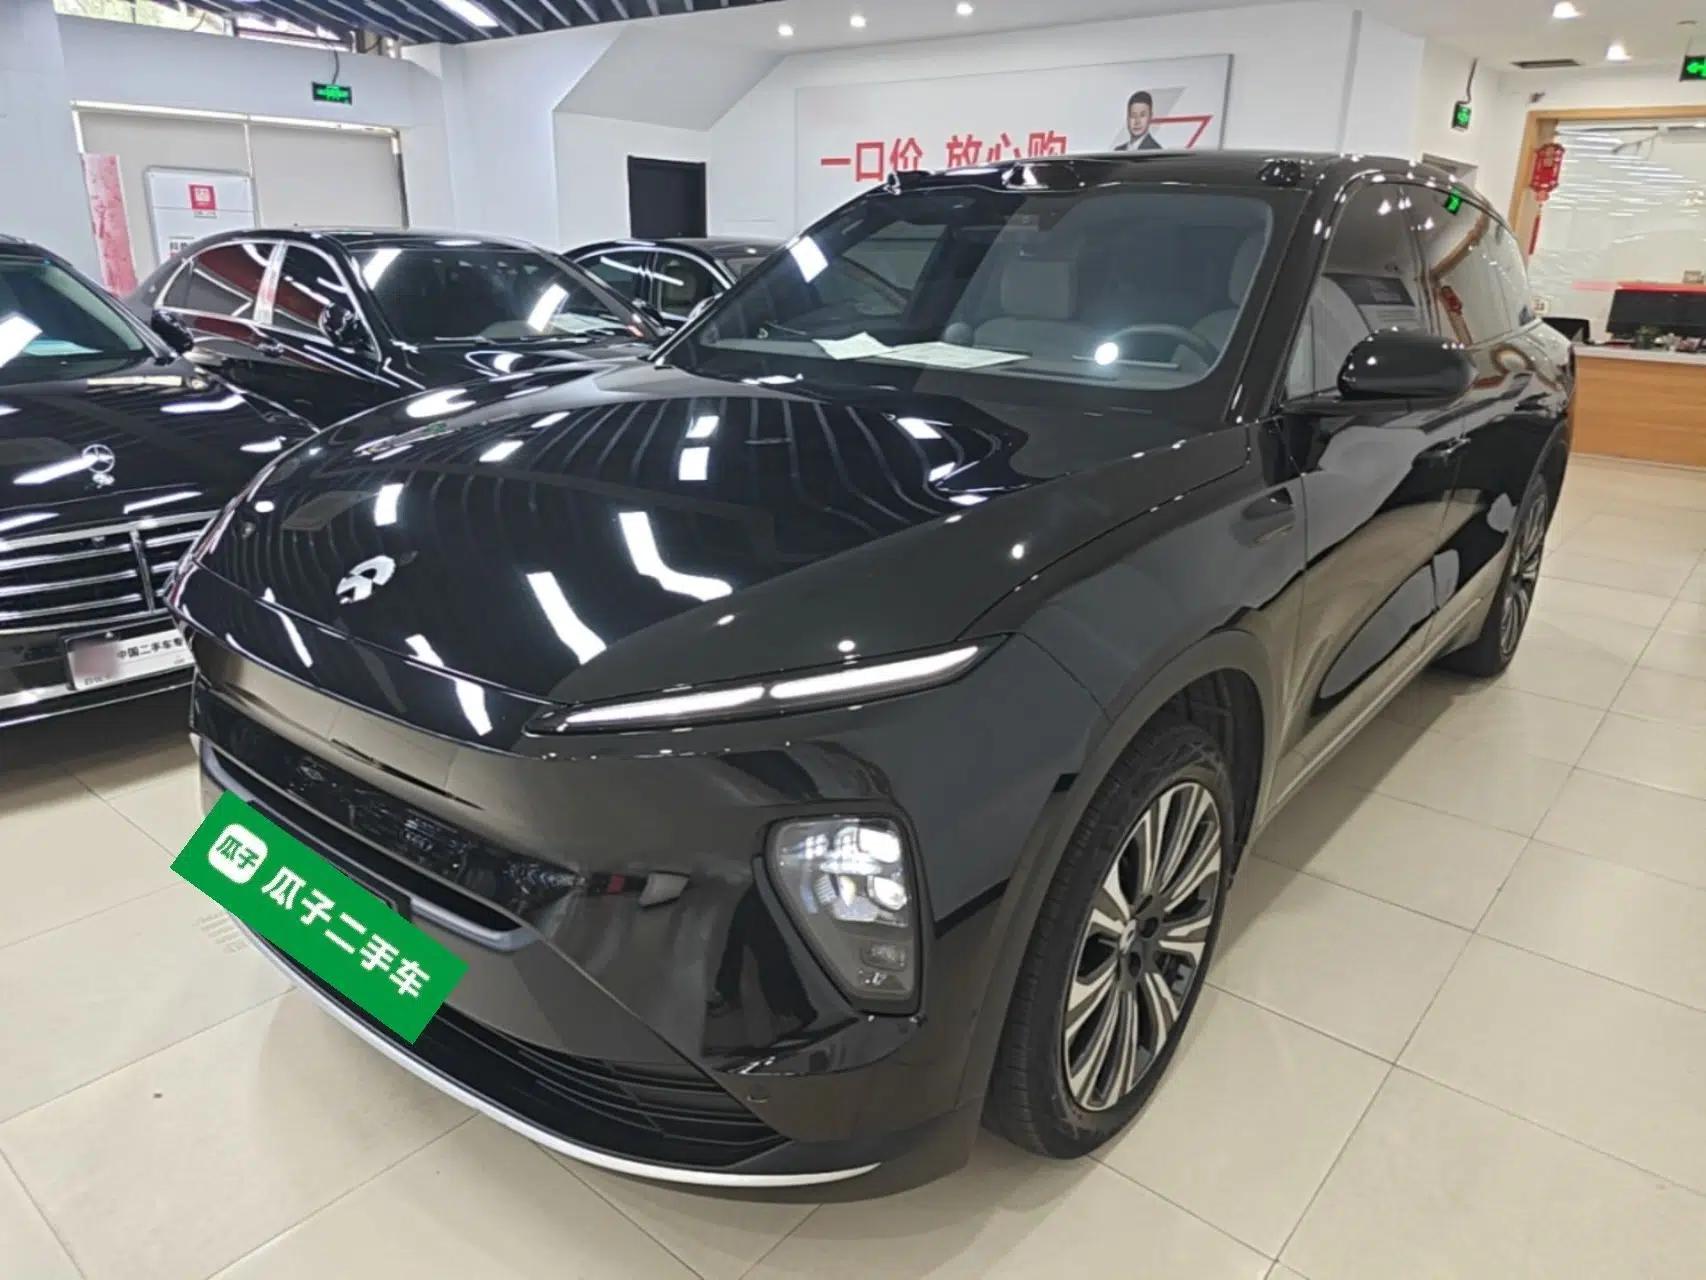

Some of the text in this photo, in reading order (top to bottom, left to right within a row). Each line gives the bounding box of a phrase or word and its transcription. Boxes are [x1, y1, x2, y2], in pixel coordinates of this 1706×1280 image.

[820, 130, 1067, 182] 一口价 放心购
